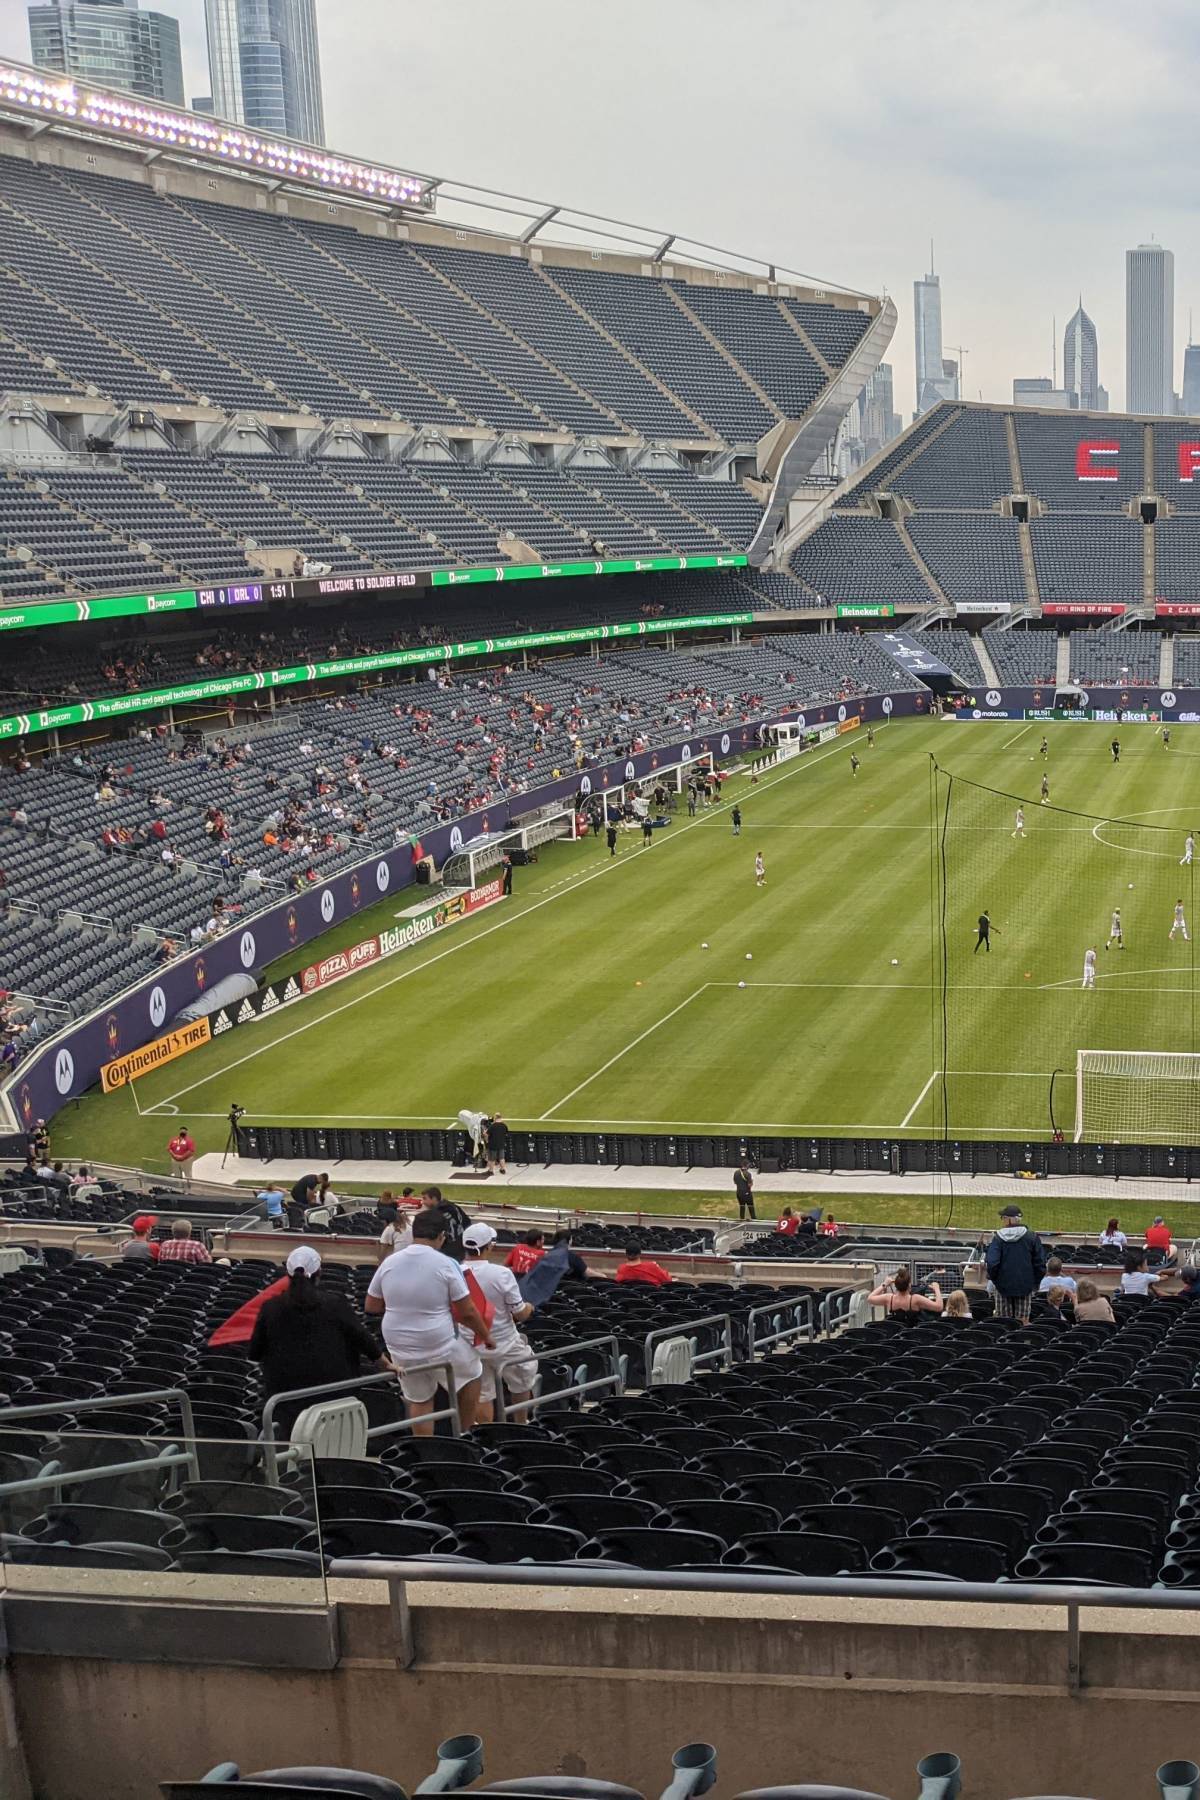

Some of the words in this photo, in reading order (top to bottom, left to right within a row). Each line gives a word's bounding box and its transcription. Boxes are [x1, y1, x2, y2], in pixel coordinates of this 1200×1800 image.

[1075, 440, 1120, 481] C
[319, 579, 354, 593] WELCOME
[356, 578, 365, 589] TO
[366, 576, 395, 589] SOLDIER
[397, 575, 416, 586] FIELD
[199, 591, 215, 605] CHI
[234, 588, 249, 601] ORL
[270, 585, 287, 598] 1:51
[155, 599, 177, 609] paycom
[842, 607, 879, 616] Heineken
[320, 666, 330, 674] The
[98, 703, 111, 713] The
[110, 700, 131, 712] official
[131, 698, 142, 707] HR
[142, 697, 153, 705] and
[153, 690, 173, 704] payroll
[173, 684, 203, 699] technology
[209, 681, 232, 692] Chicago
[232, 679, 243, 689] Fire
[243, 678, 252, 687] FC
[48, 713, 72, 724] paycom
[2, 723, 13, 733] FC
[379, 916, 434, 954] Heineken
[320, 955, 348, 980] PIZZA
[351, 941, 376, 966] PUFF
[283, 987, 301, 1001] adidas
[261, 998, 280, 1012] adidas
[237, 1009, 256, 1024] adidas
[213, 1021, 233, 1036] adidas
[106, 1042, 172, 1088] Continental
[182, 1024, 207, 1046] TIRE
[780, 1220, 788, 1230] 9
